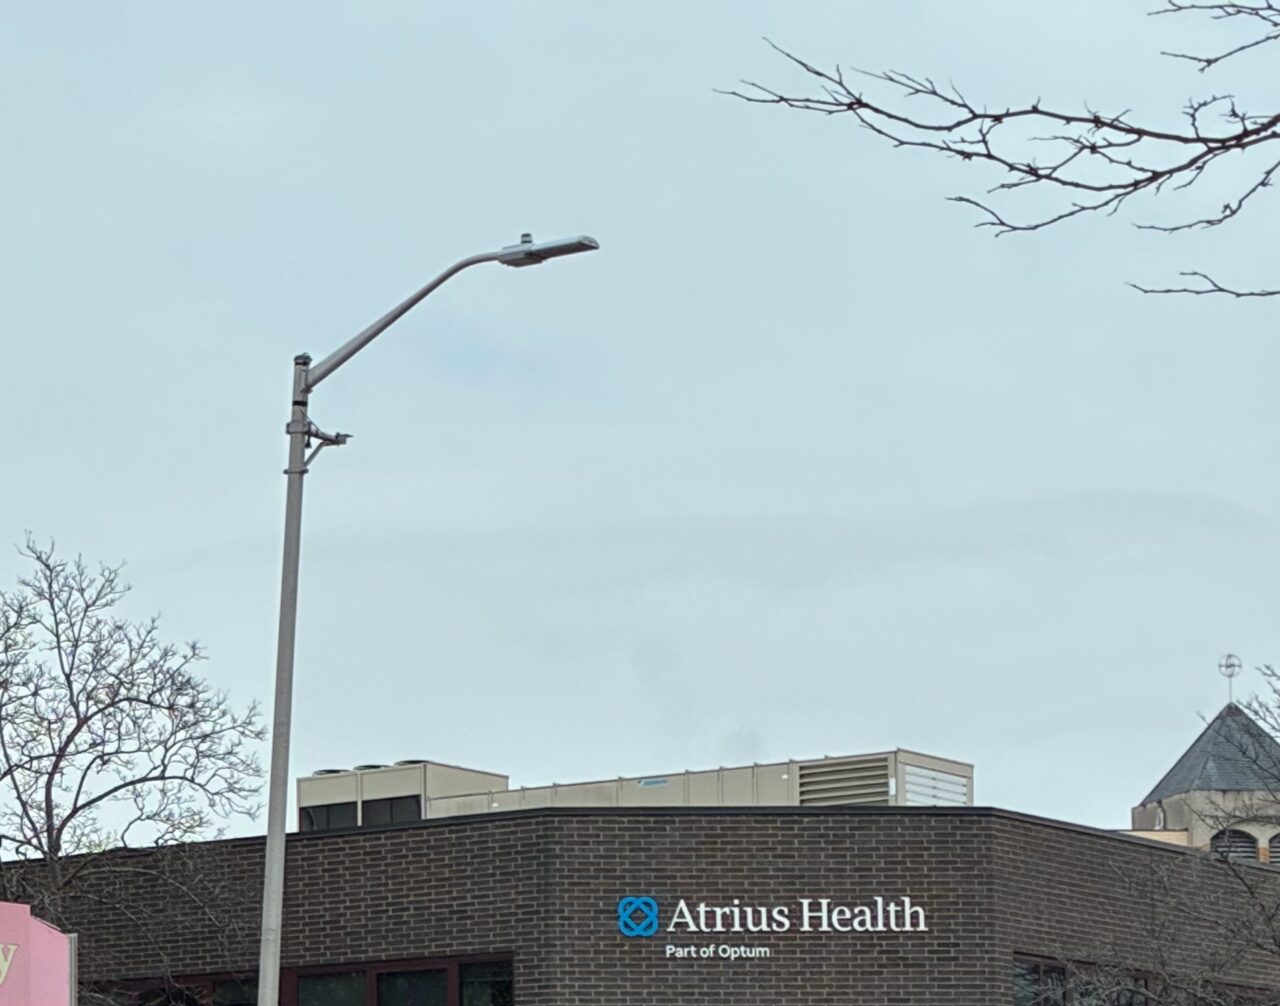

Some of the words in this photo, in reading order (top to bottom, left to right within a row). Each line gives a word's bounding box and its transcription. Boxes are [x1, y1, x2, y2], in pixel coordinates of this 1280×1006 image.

[666, 898, 791, 932] Atrius
[799, 896, 928, 932] Health
[665, 944, 697, 958] Part
[699, 944, 716, 958] of
[718, 944, 770, 960] Optum
